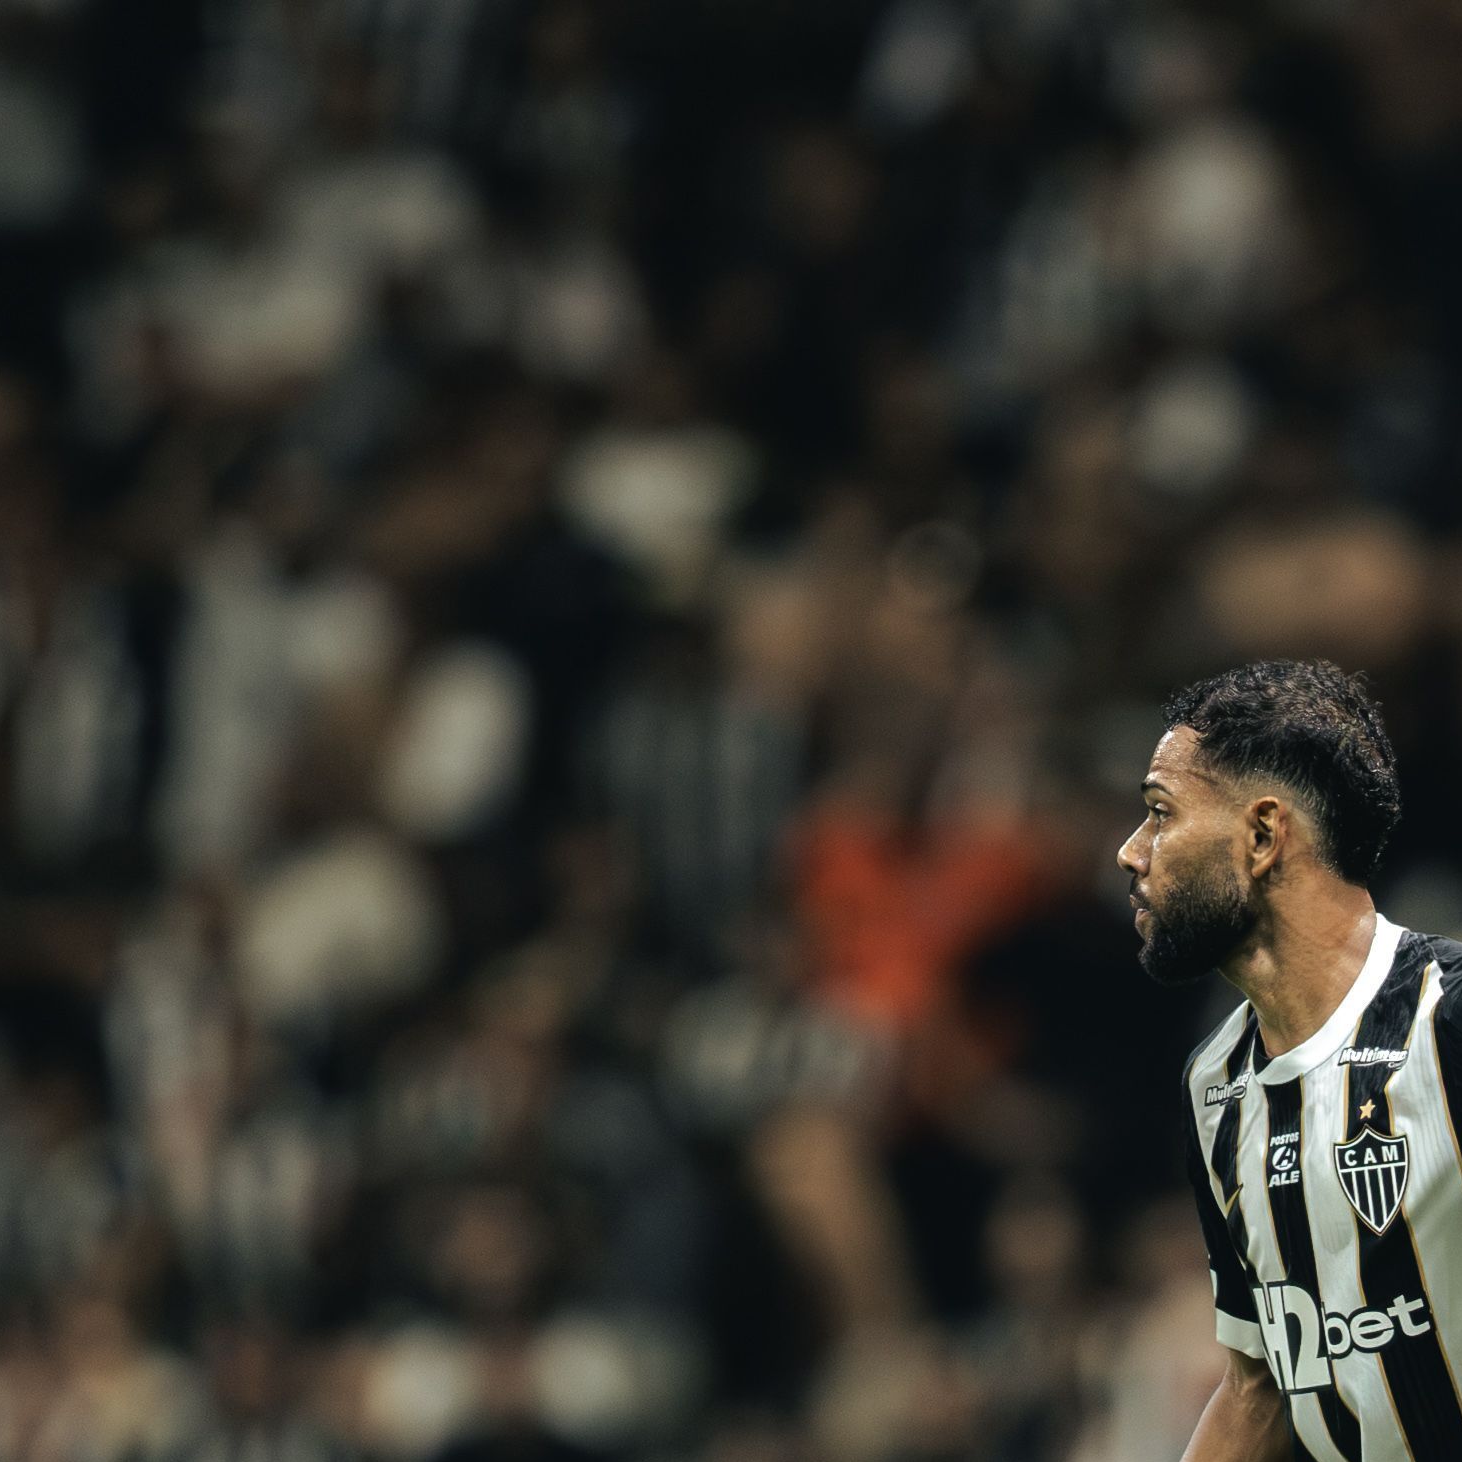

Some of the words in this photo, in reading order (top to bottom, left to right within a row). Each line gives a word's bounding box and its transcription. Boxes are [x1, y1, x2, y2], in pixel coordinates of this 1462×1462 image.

[1270, 1132, 1299, 1147] POSTOS
[1344, 1144, 1399, 1167] CAM
[1268, 1170, 1300, 1188] ALE
